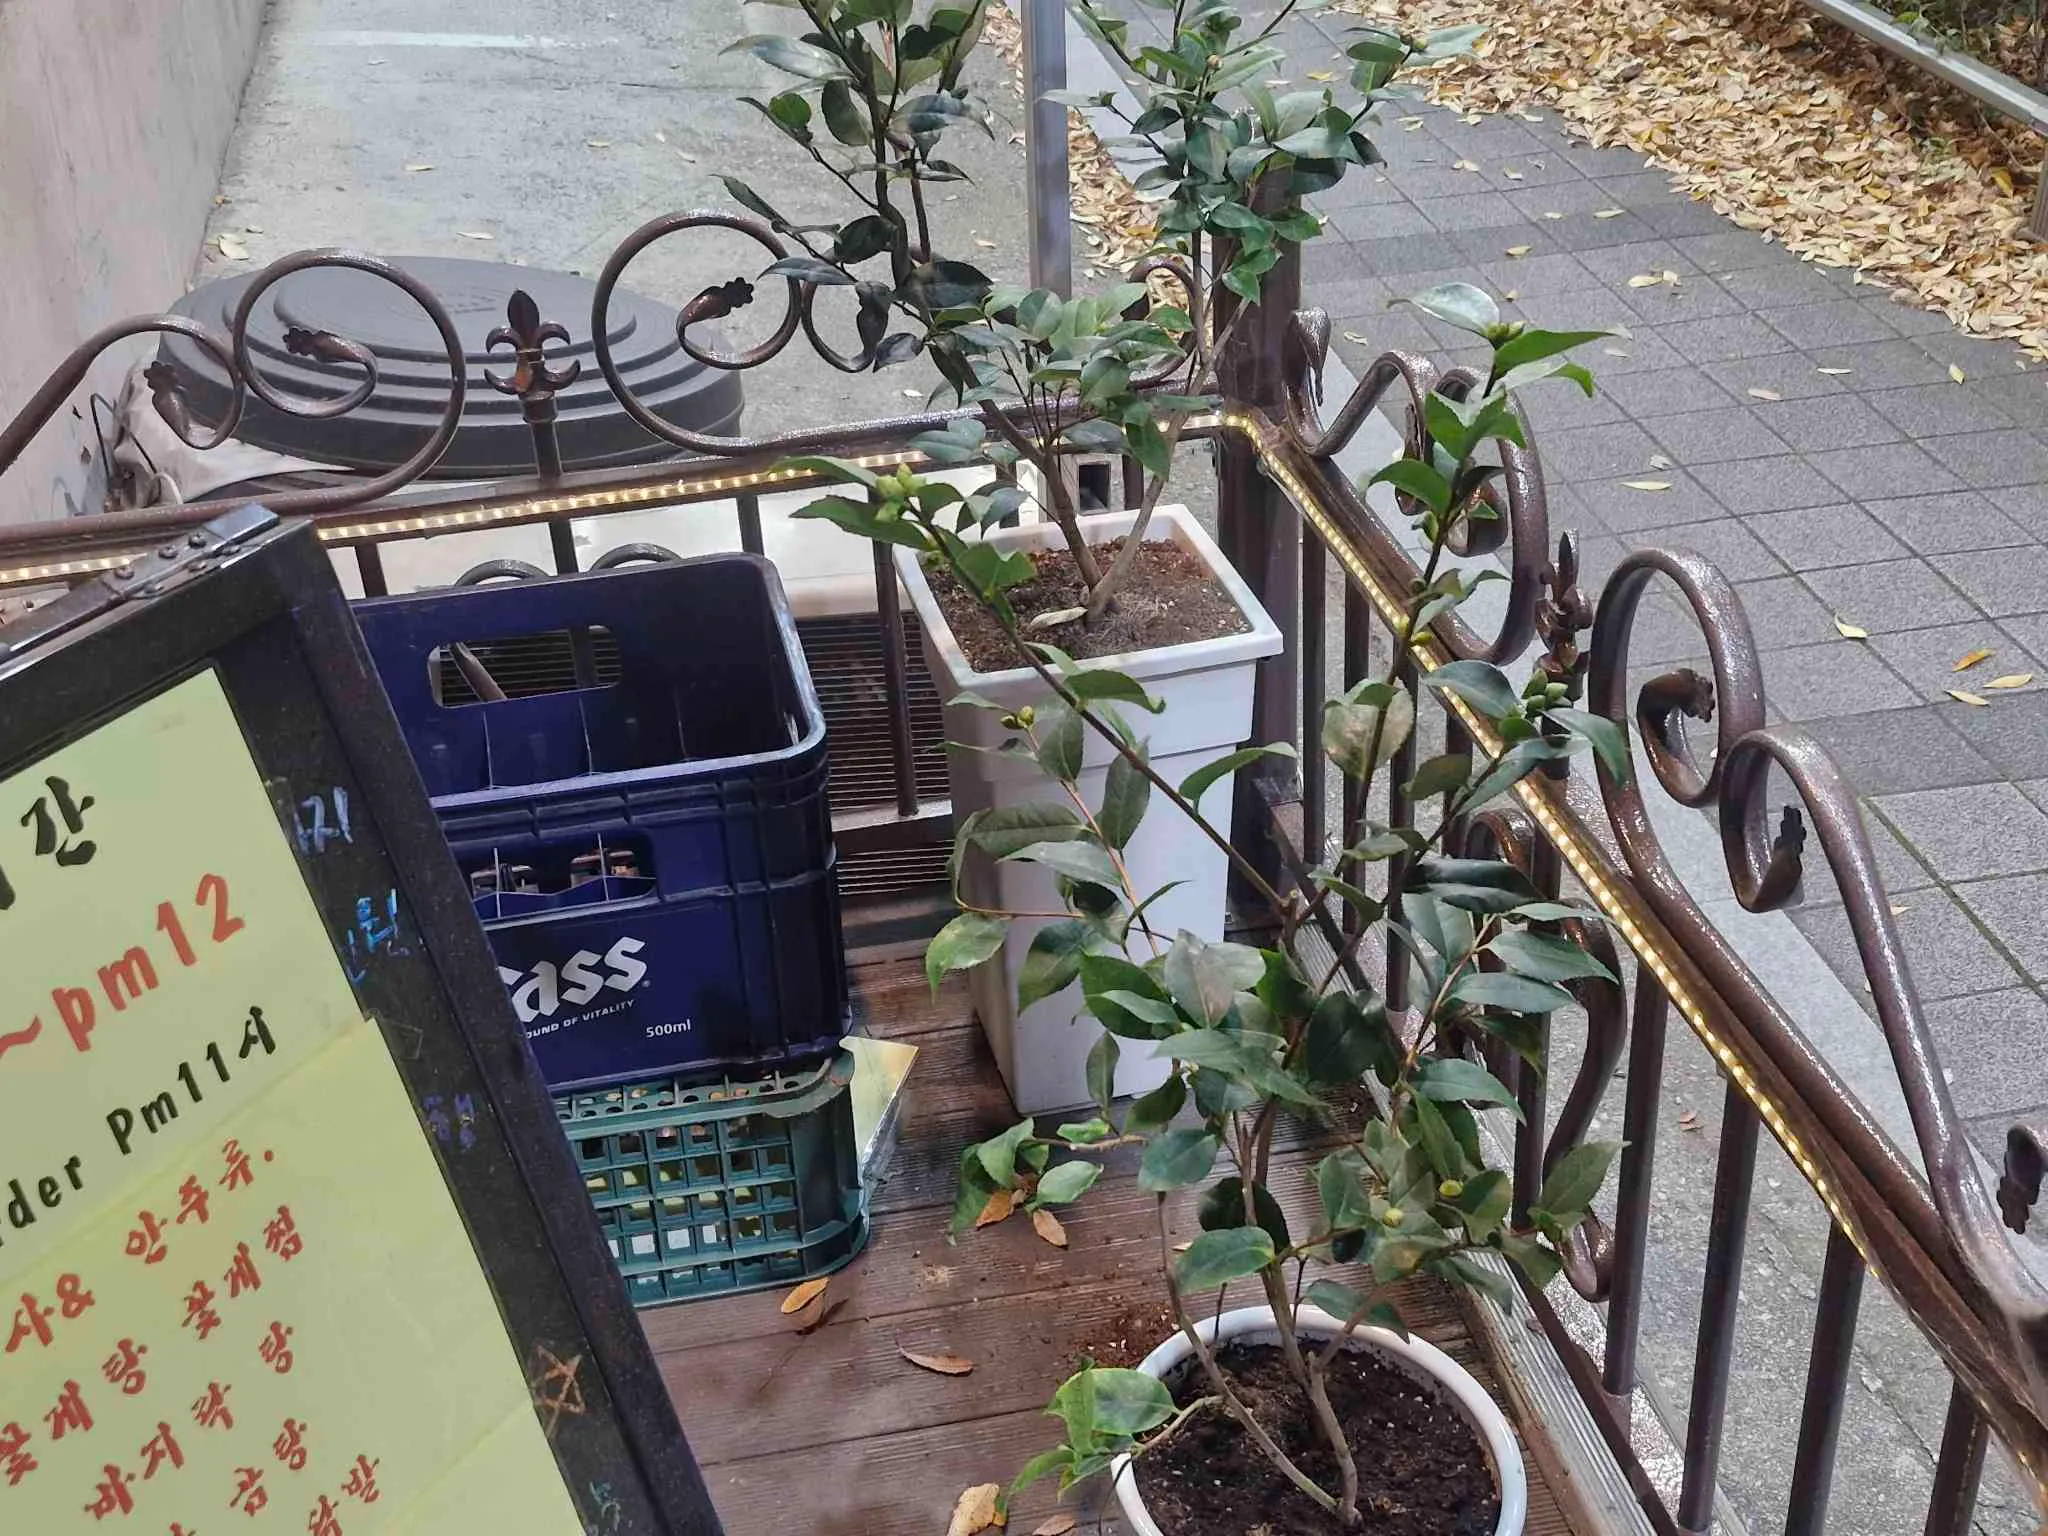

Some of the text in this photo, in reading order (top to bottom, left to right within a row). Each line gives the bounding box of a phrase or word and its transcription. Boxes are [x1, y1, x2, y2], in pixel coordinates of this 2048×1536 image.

[496, 936, 648, 1022] ass
[563, 1016, 579, 1028] OF
[582, 999, 635, 1021] VITALITY
[646, 1018, 692, 1038] 500ml
[0, 1155, 84, 1247] der
